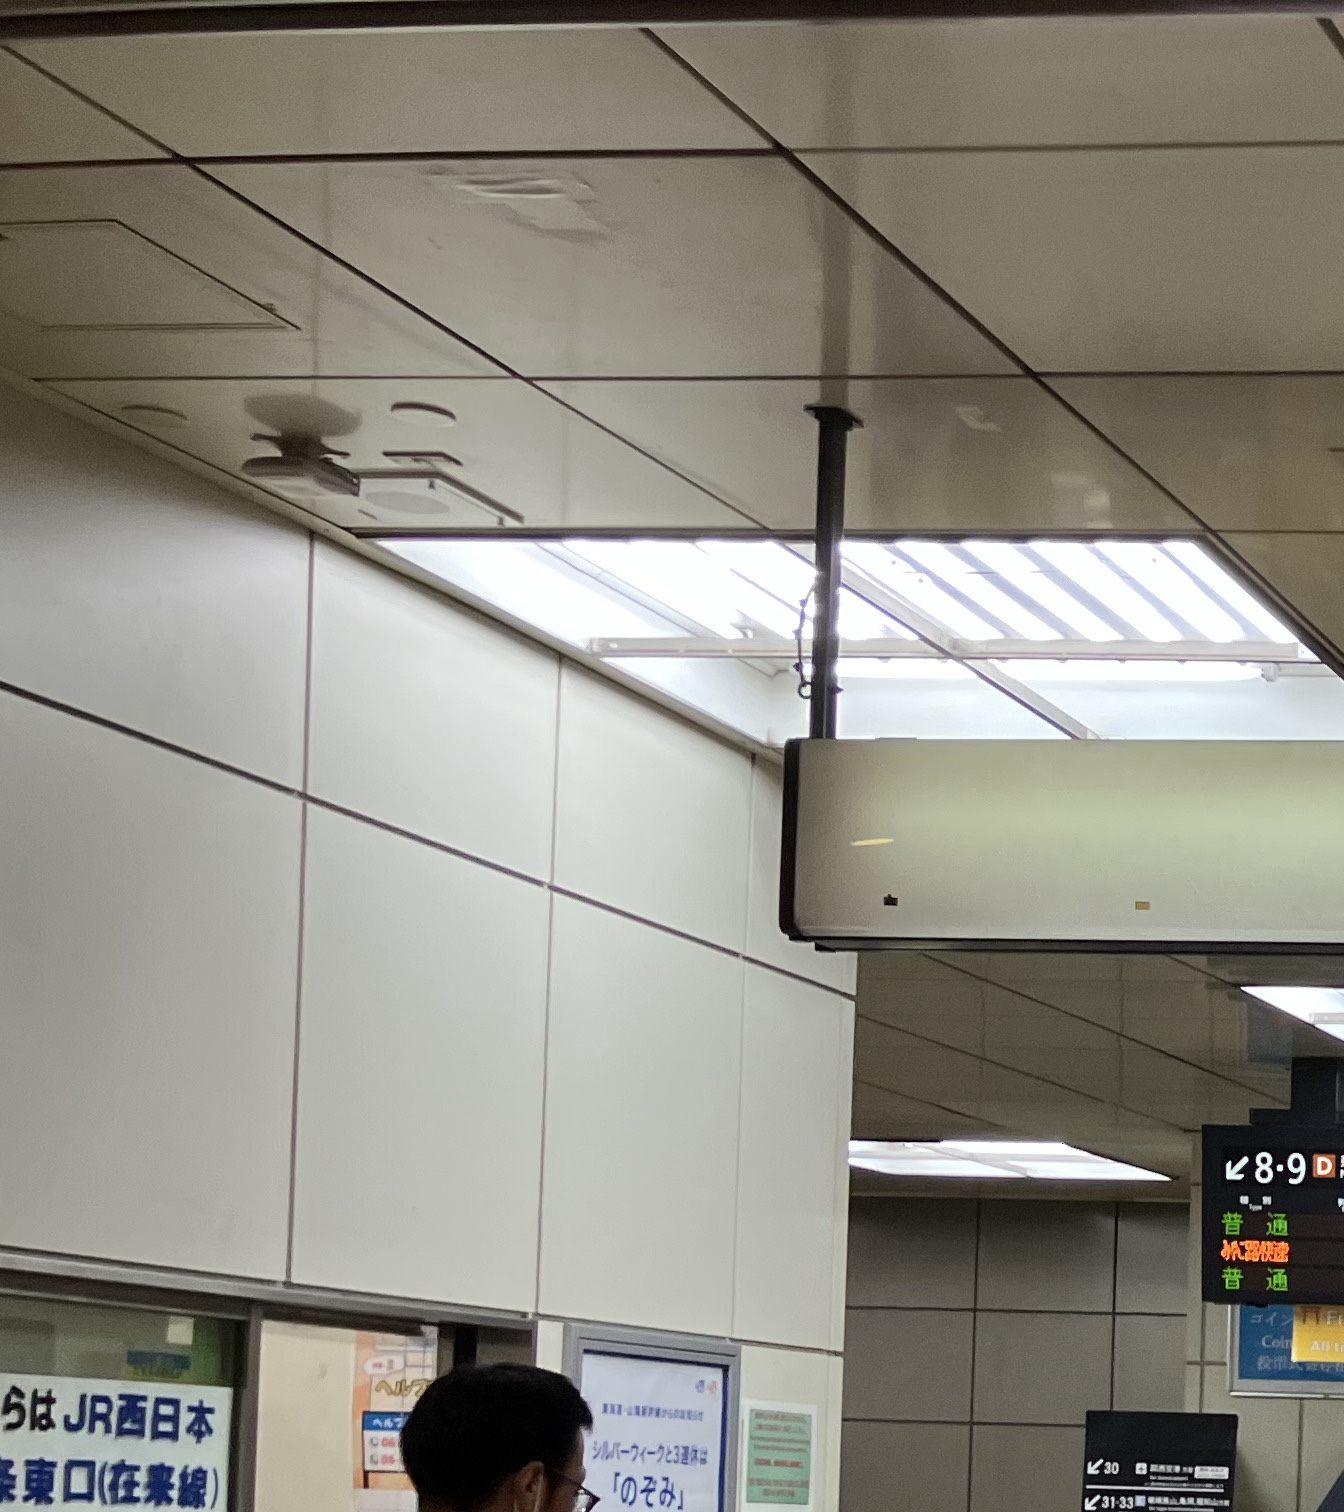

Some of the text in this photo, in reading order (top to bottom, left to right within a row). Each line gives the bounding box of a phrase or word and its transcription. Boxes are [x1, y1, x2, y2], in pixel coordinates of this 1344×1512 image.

[1316, 1156, 1334, 1176] D
[1104, 1461, 1120, 1475] 30
[612, 1471, 685, 1511] 「のぞみ」
